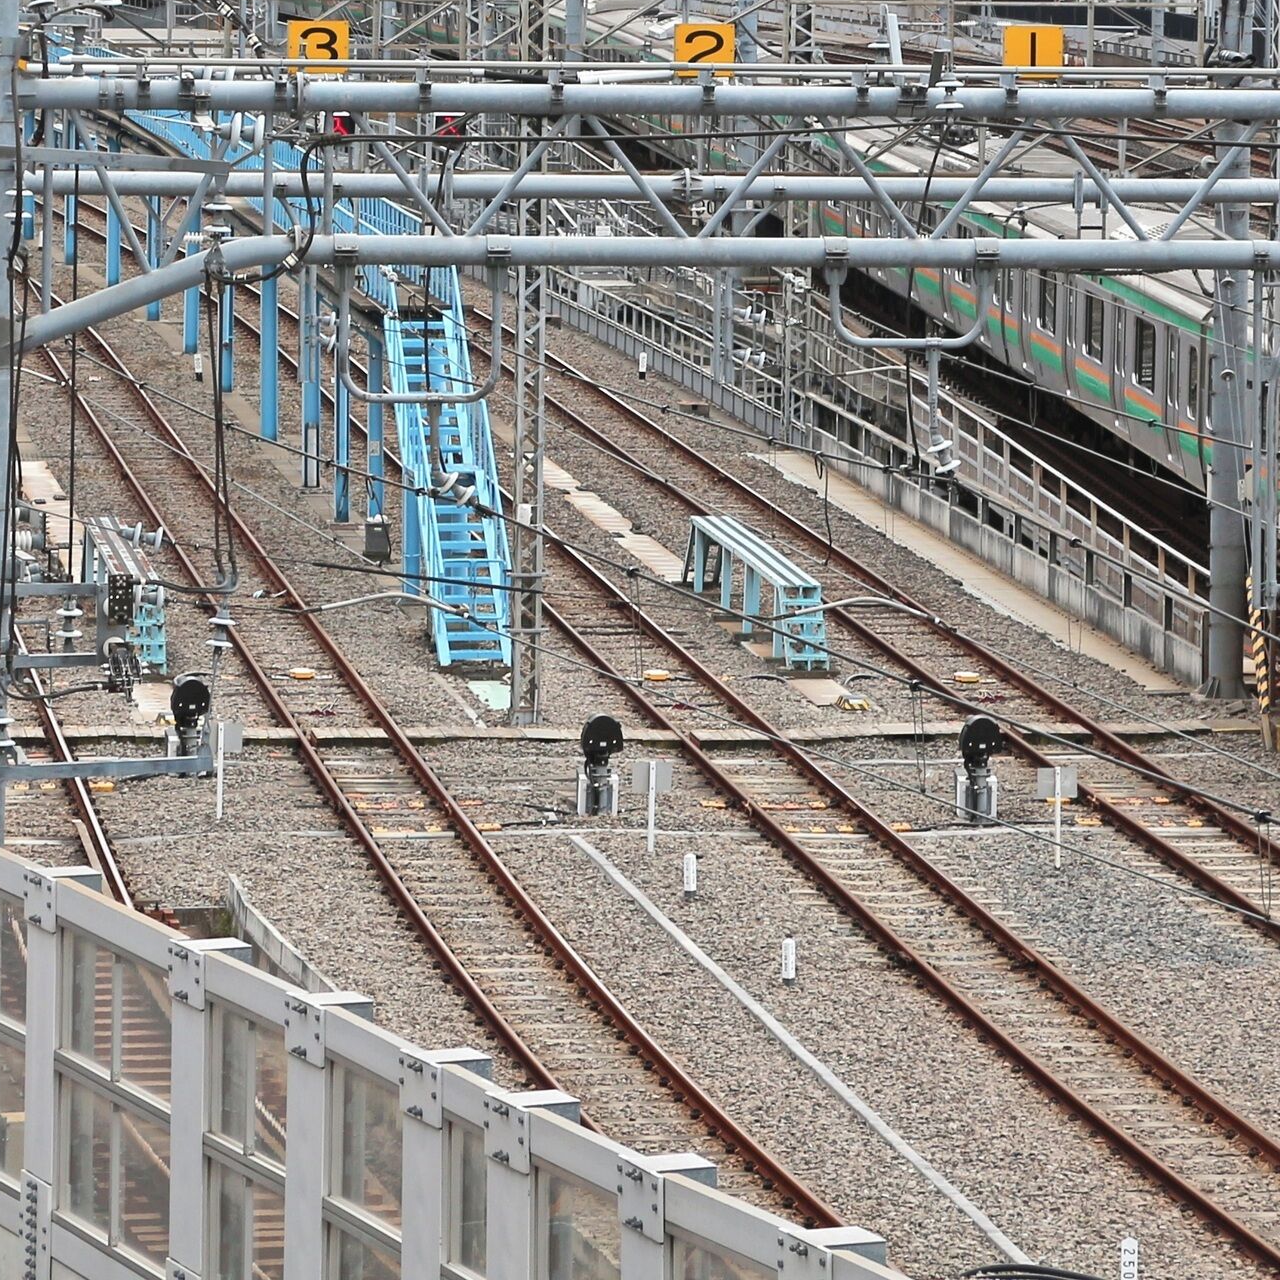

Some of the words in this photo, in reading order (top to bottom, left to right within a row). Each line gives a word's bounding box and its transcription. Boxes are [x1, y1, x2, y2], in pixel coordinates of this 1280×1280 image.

[300, 27, 338, 60] 3
[684, 30, 724, 63] 2
[1030, 31, 1037, 66] 1
